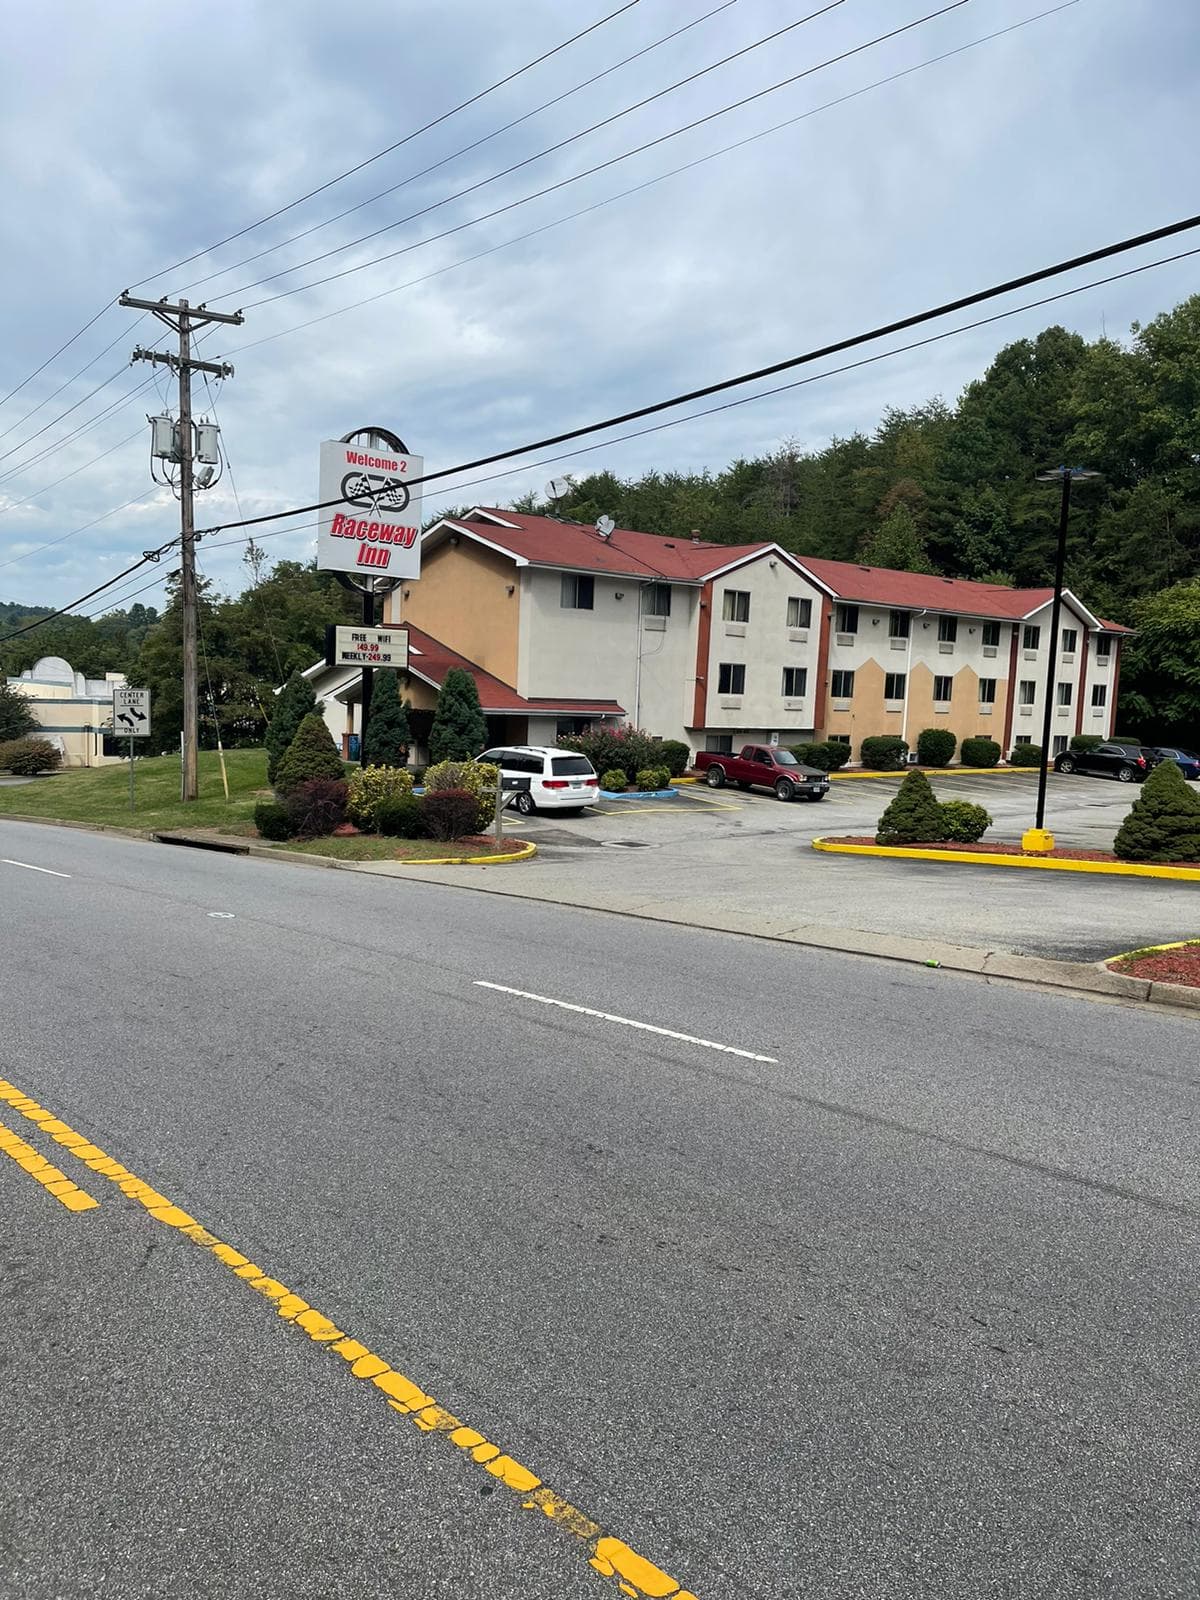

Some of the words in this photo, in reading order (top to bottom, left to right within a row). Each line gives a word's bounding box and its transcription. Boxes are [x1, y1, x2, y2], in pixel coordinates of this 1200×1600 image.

[346, 451, 398, 471] Welcome
[400, 460, 407, 473] 2
[331, 513, 417, 548] Raceway
[356, 543, 391, 569] Inn
[352, 633, 366, 642] FREE
